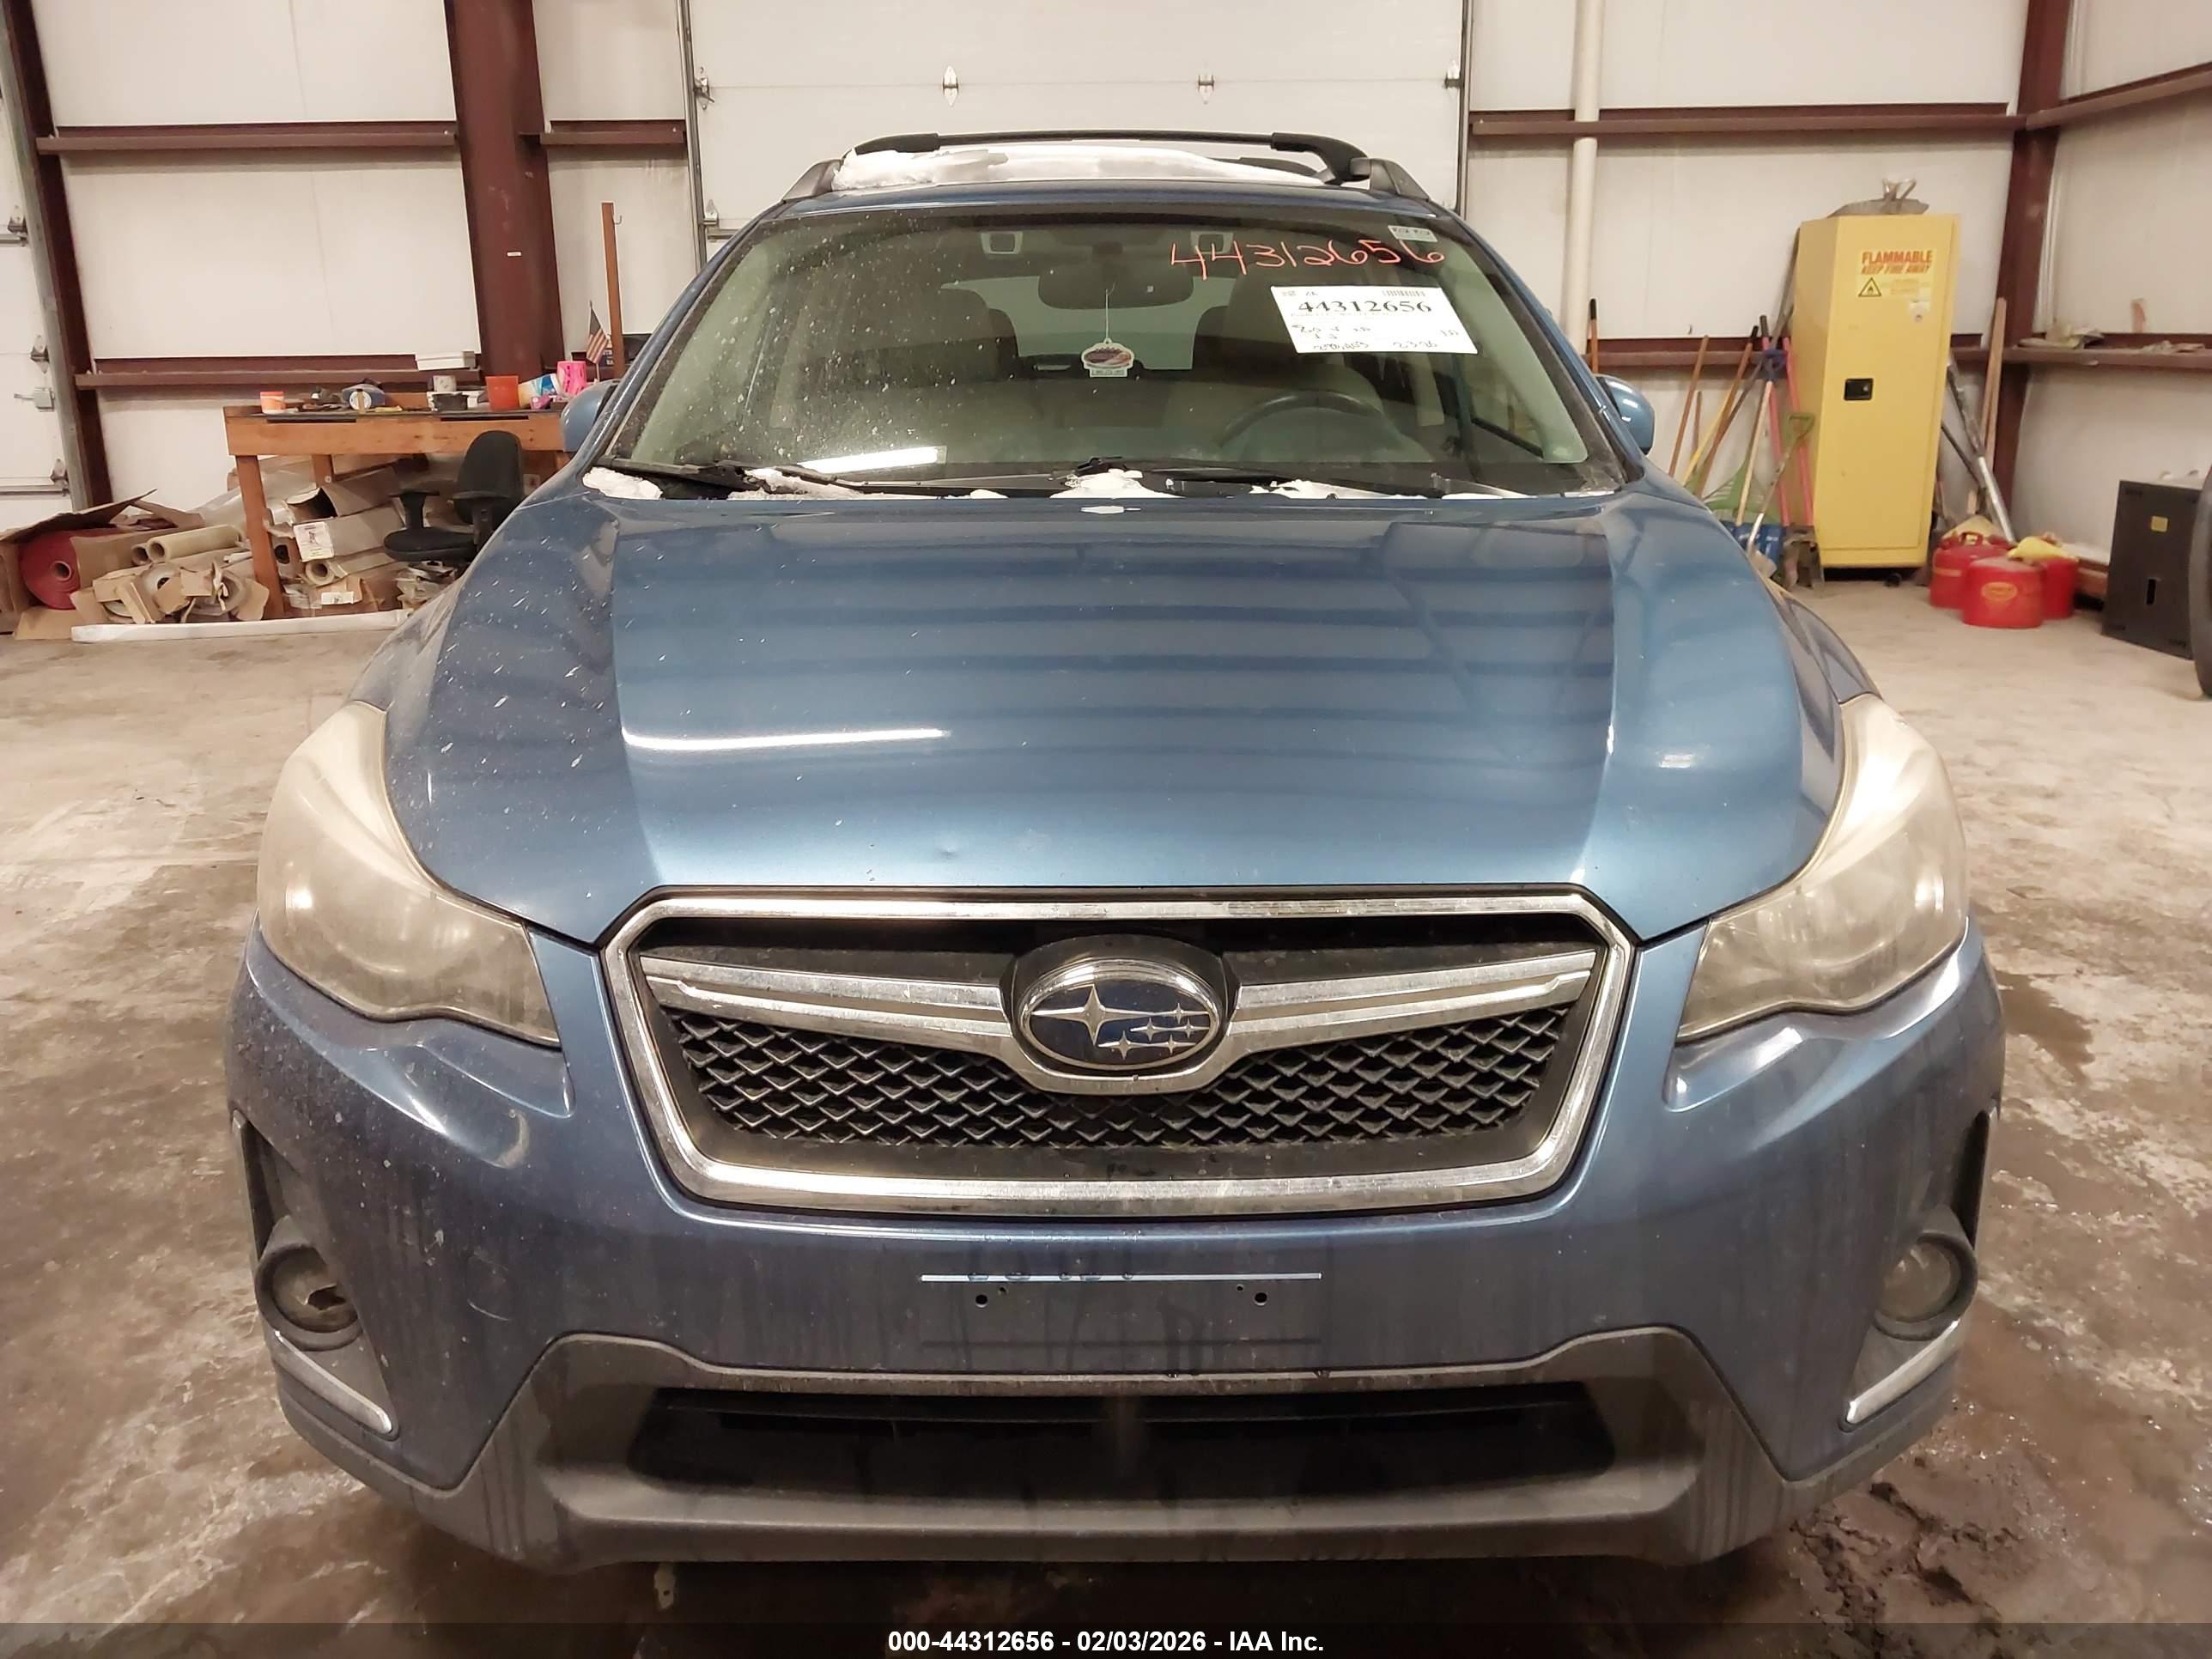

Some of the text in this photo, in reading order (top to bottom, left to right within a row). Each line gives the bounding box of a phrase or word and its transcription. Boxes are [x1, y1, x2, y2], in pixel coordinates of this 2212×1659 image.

[1170, 240, 1445, 281] 44312656
[1862, 251, 1933, 264] FLAMMABLE
[1298, 301, 1432, 313] 44312656
